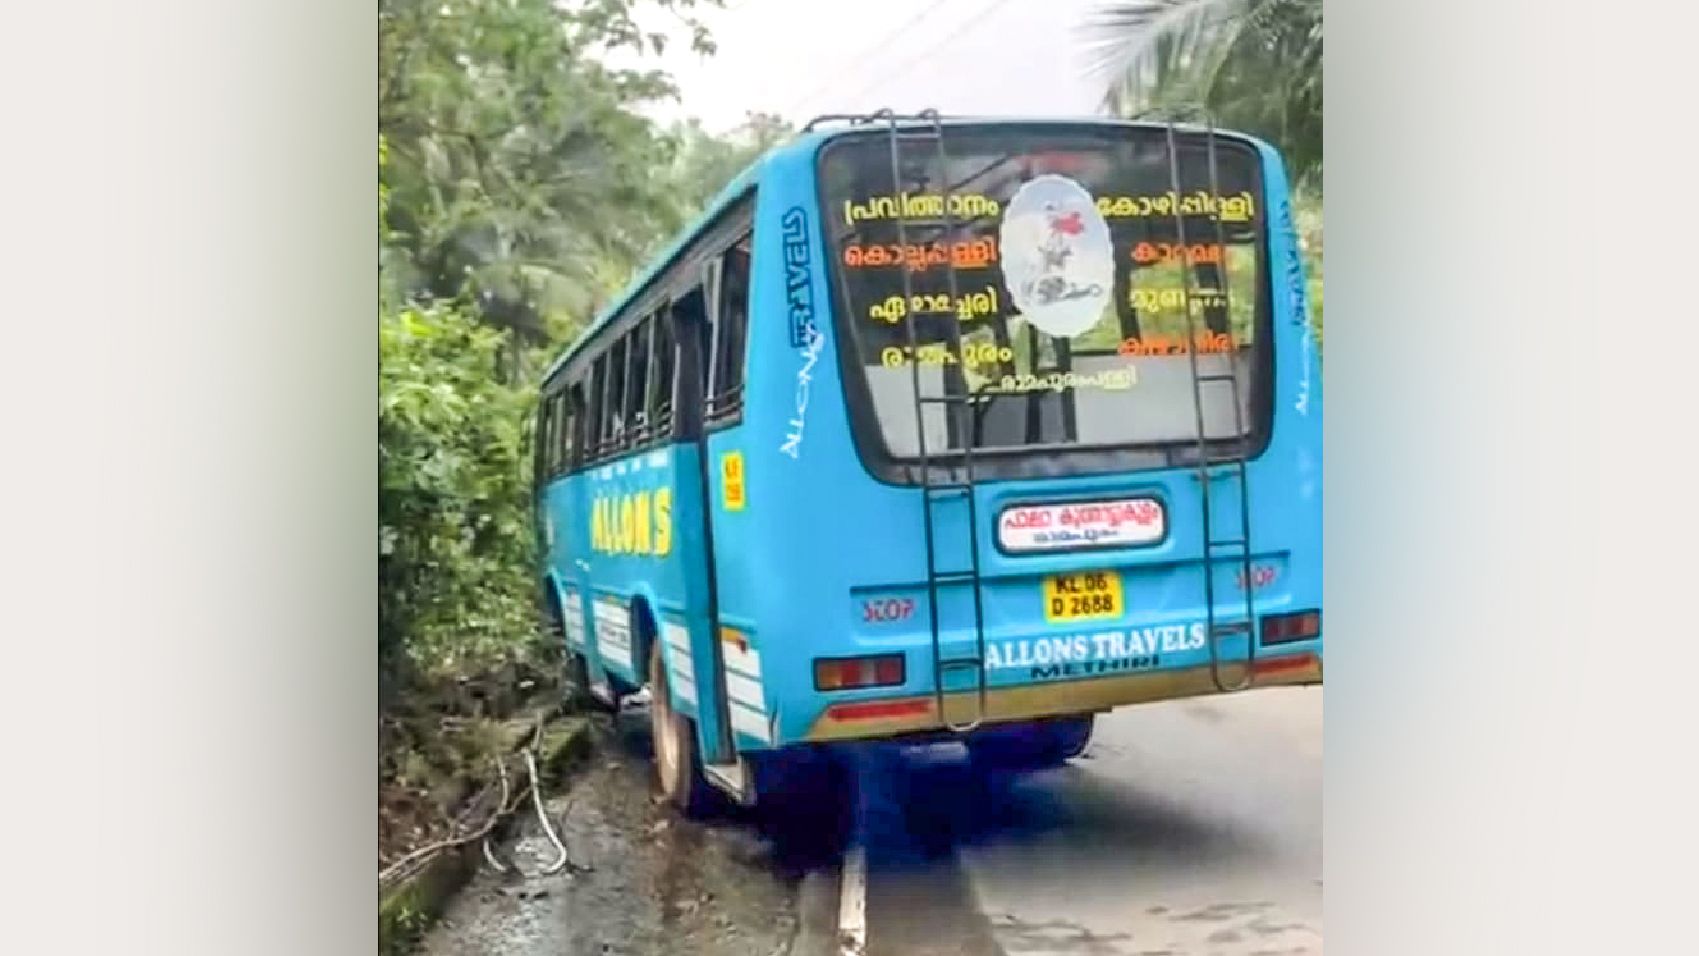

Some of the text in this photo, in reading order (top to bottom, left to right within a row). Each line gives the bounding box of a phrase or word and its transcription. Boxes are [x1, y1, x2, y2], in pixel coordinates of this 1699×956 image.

[591, 486, 672, 557] ALLONS
[1056, 573, 1108, 595] KL 06
[1052, 594, 1114, 617] D 2688
[984, 622, 1206, 670] ALLONS TRAVELS
